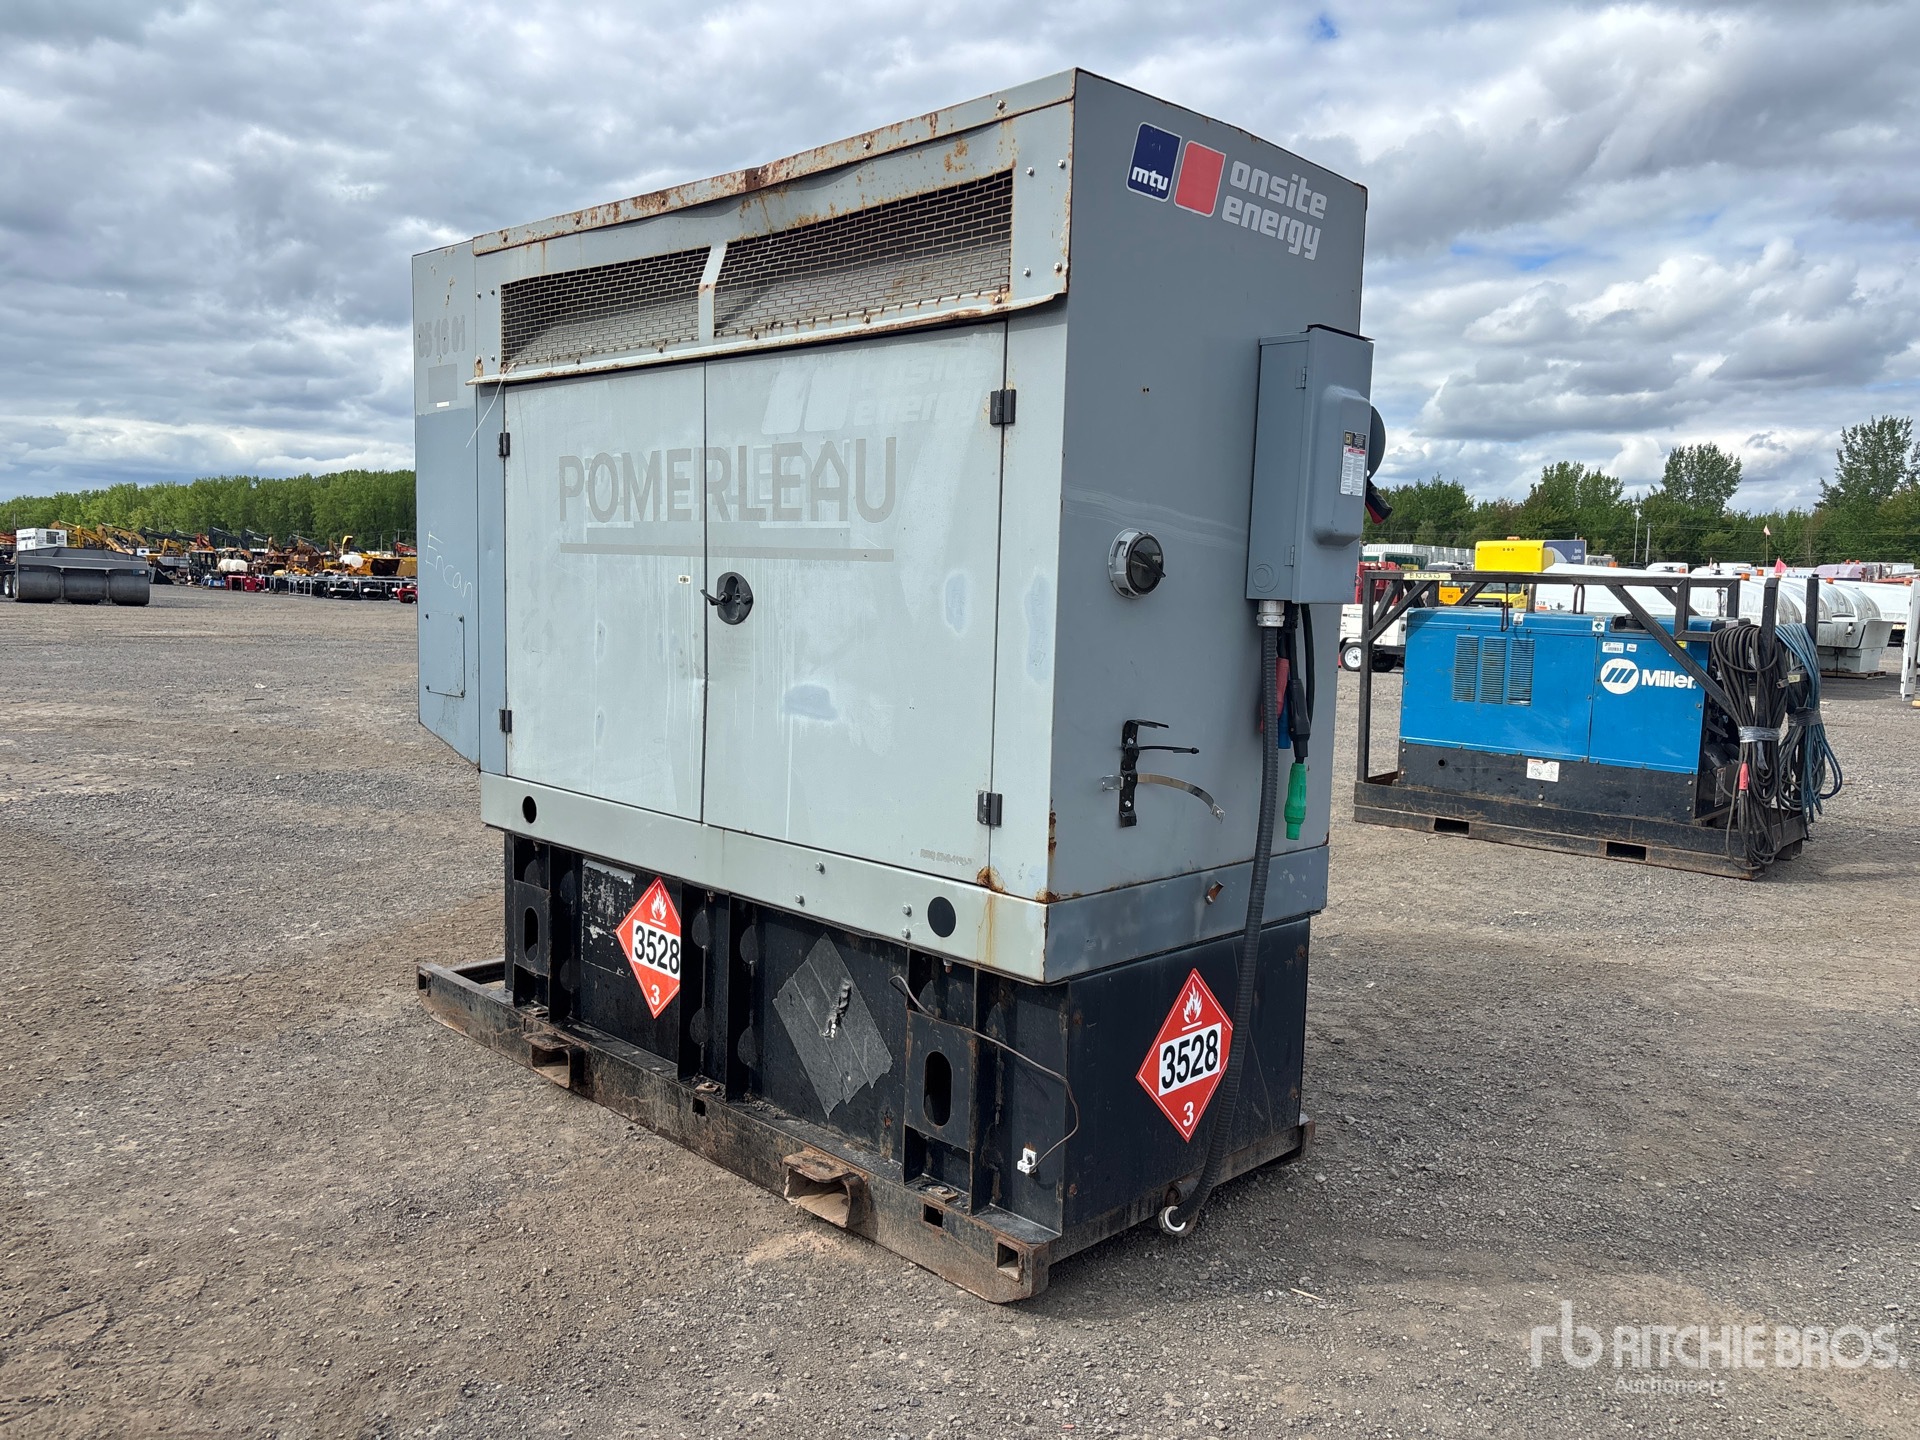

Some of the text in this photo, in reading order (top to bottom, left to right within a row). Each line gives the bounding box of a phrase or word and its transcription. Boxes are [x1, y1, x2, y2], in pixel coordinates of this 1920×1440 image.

[1131, 166, 1169, 191] mtu
[1229, 160, 1328, 219] onsite
[1221, 195, 1321, 261] energy
[558, 437, 897, 524] POMERLEAU
[1641, 669, 1695, 689] Miller
[634, 925, 680, 975] 3528
[651, 984, 660, 1006] 3
[1161, 1029, 1219, 1089] 3528
[1183, 1101, 1194, 1127] 3
